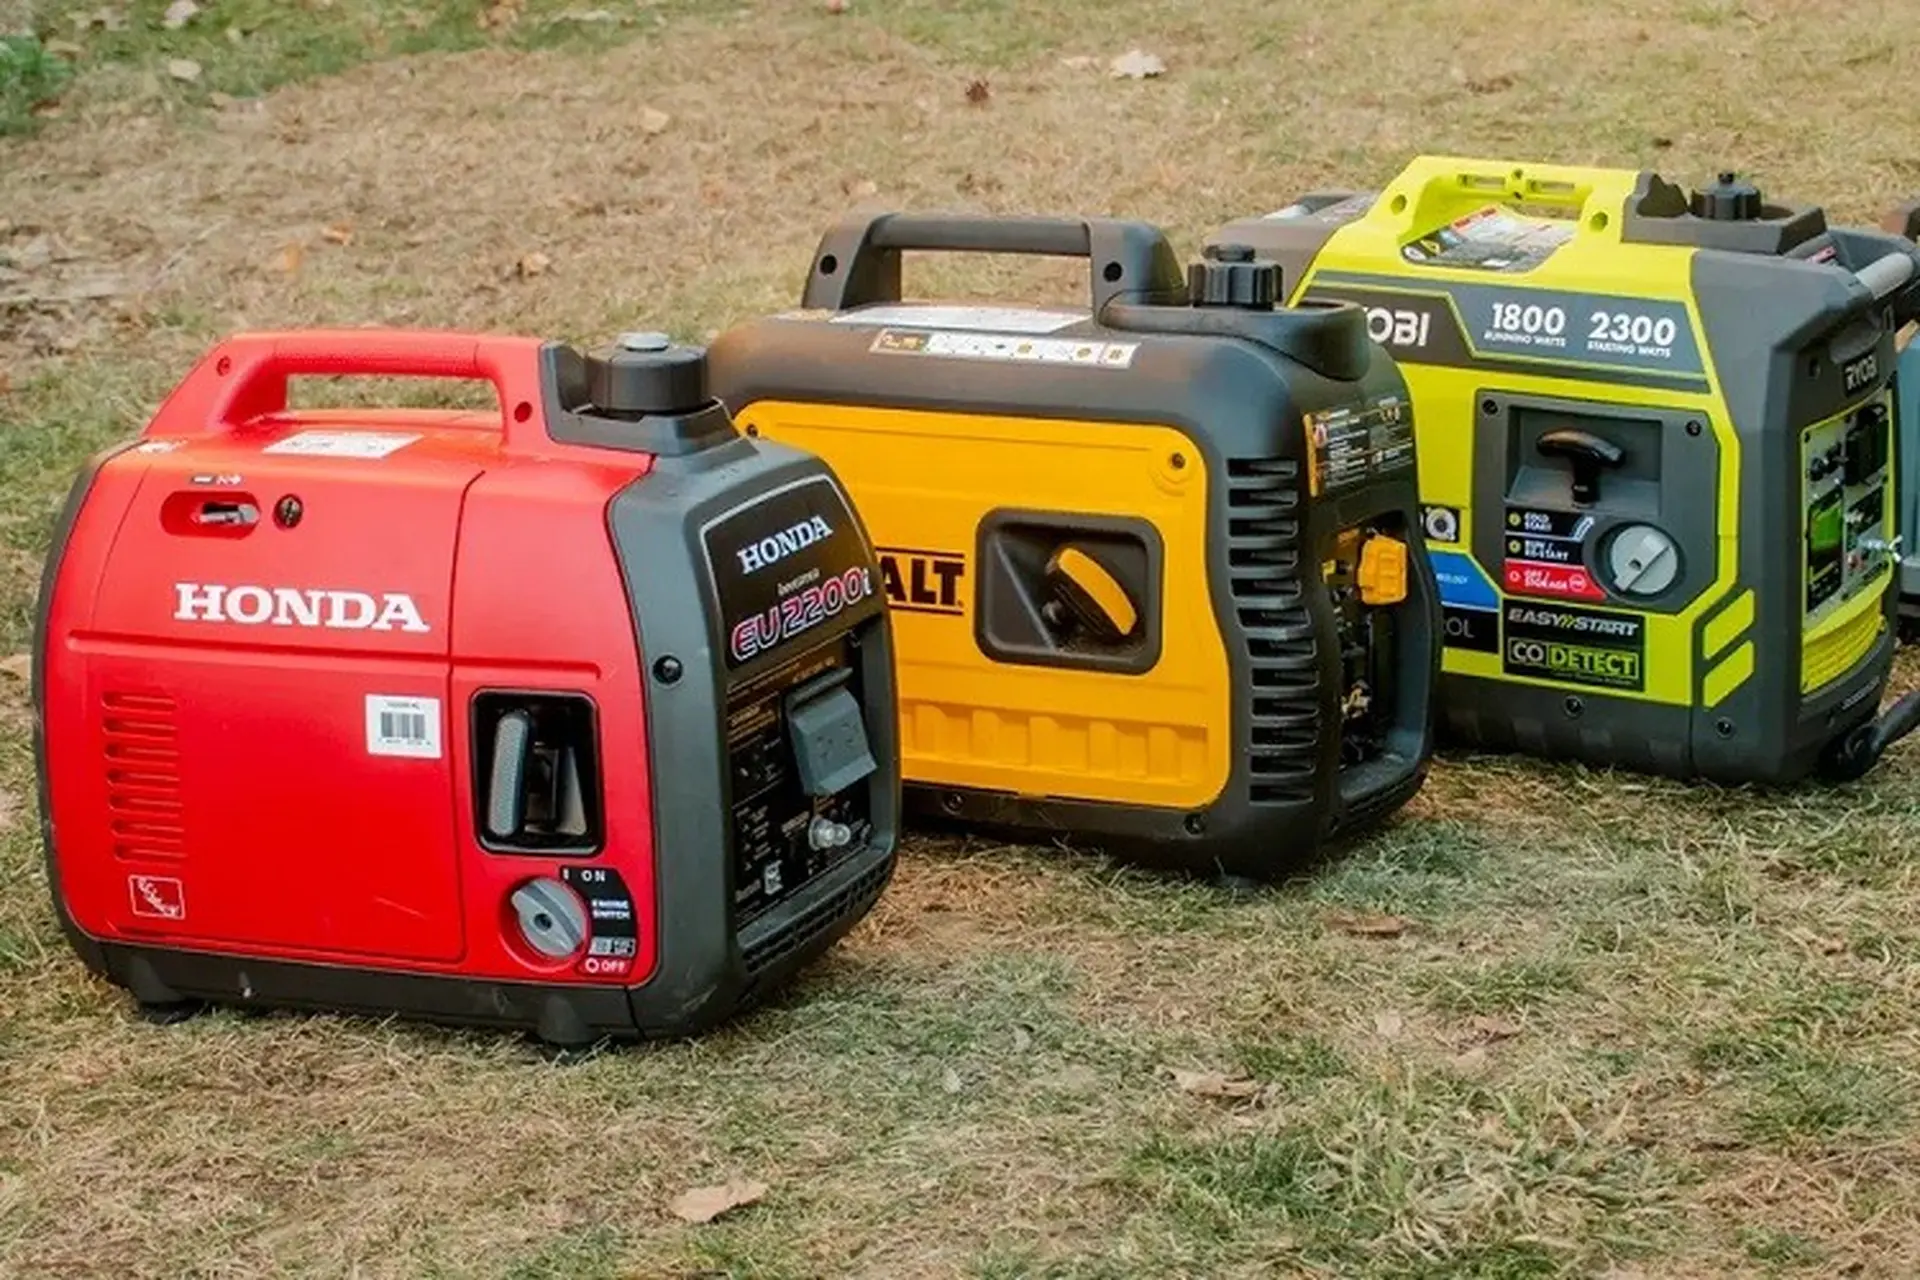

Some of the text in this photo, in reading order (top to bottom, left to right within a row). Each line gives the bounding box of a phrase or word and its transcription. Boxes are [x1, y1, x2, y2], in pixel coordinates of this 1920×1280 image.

[1363, 306, 1431, 347] OBI
[1492, 302, 1565, 336] 1800
[1588, 311, 1675, 346] 2300
[736, 515, 833, 575] HONDA
[174, 583, 431, 633] HONDA
[731, 566, 872, 661] EU2200i
[1508, 607, 1639, 636] EASY START
[1513, 641, 1635, 676] CO DETECT
[581, 870, 606, 882] ON
